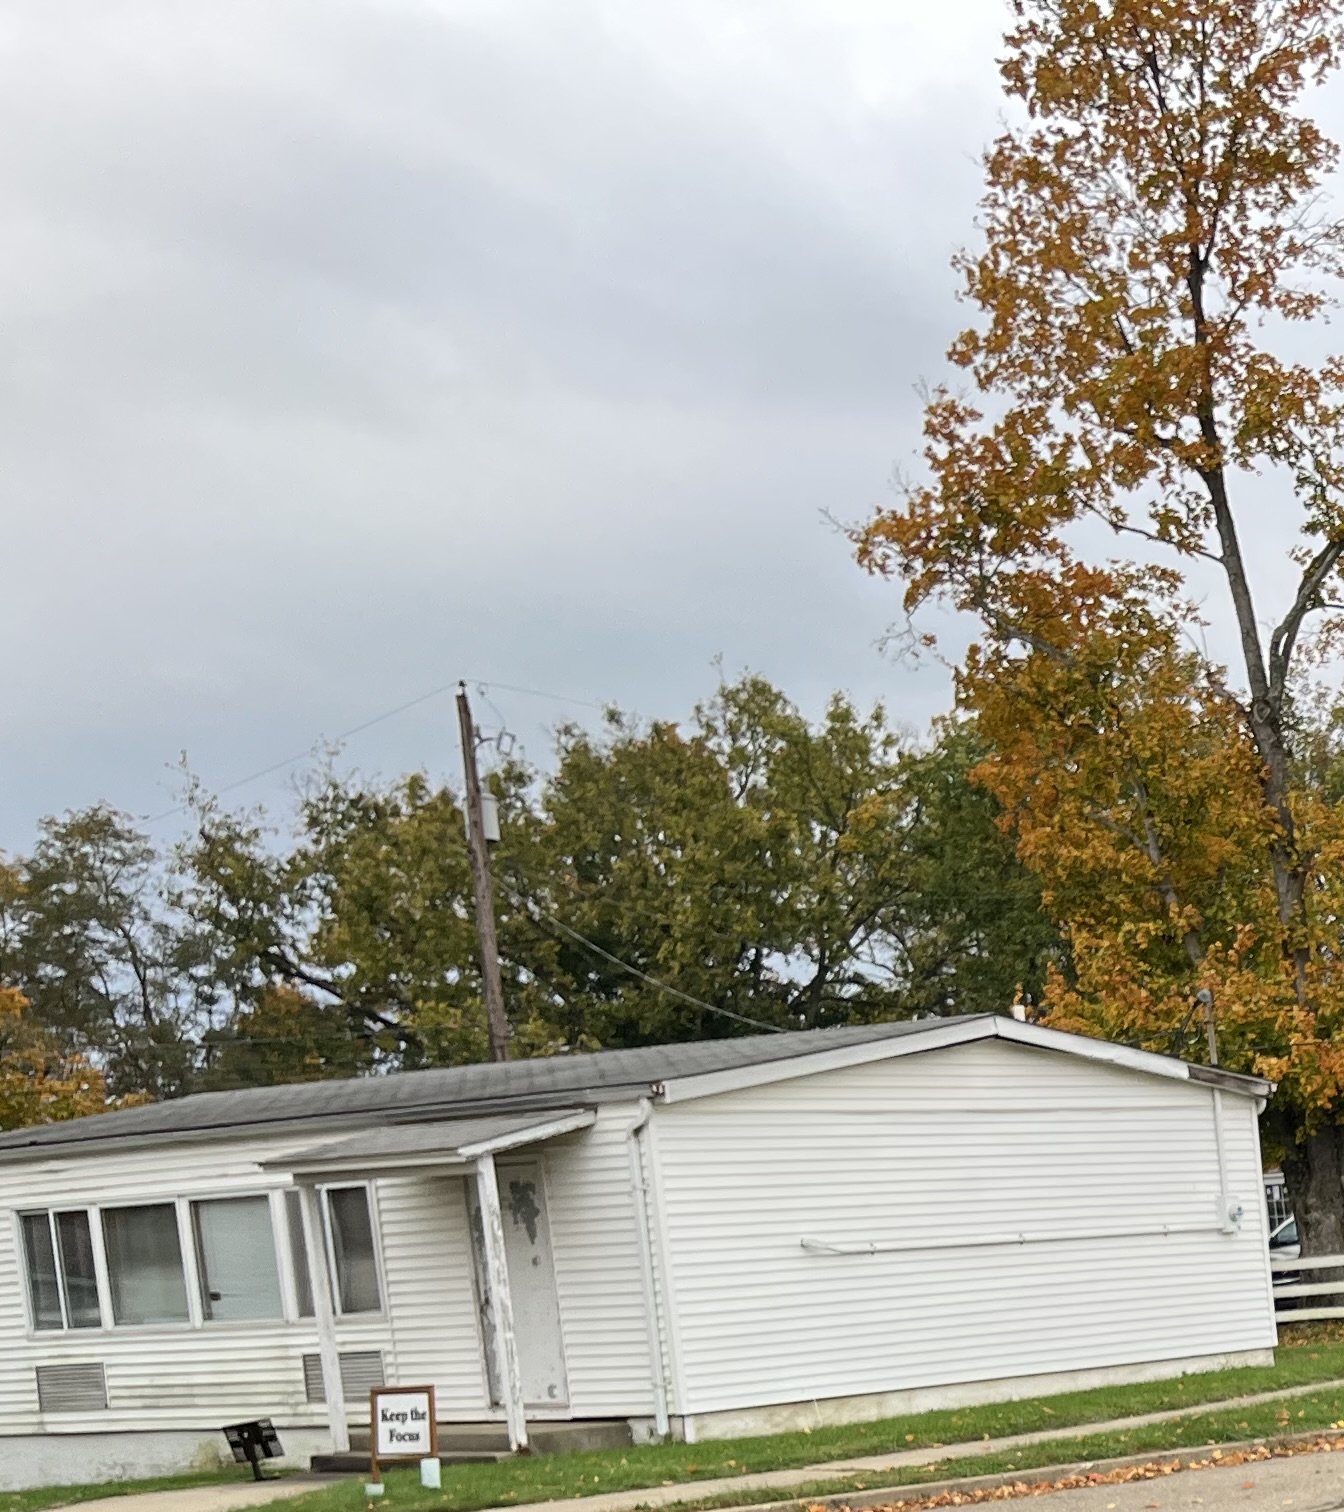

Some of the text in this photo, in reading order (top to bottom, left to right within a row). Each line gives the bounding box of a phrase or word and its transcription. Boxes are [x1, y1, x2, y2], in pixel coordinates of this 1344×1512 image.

[381, 1406, 427, 1425] Keep the
[389, 1429, 420, 1443] Focus
